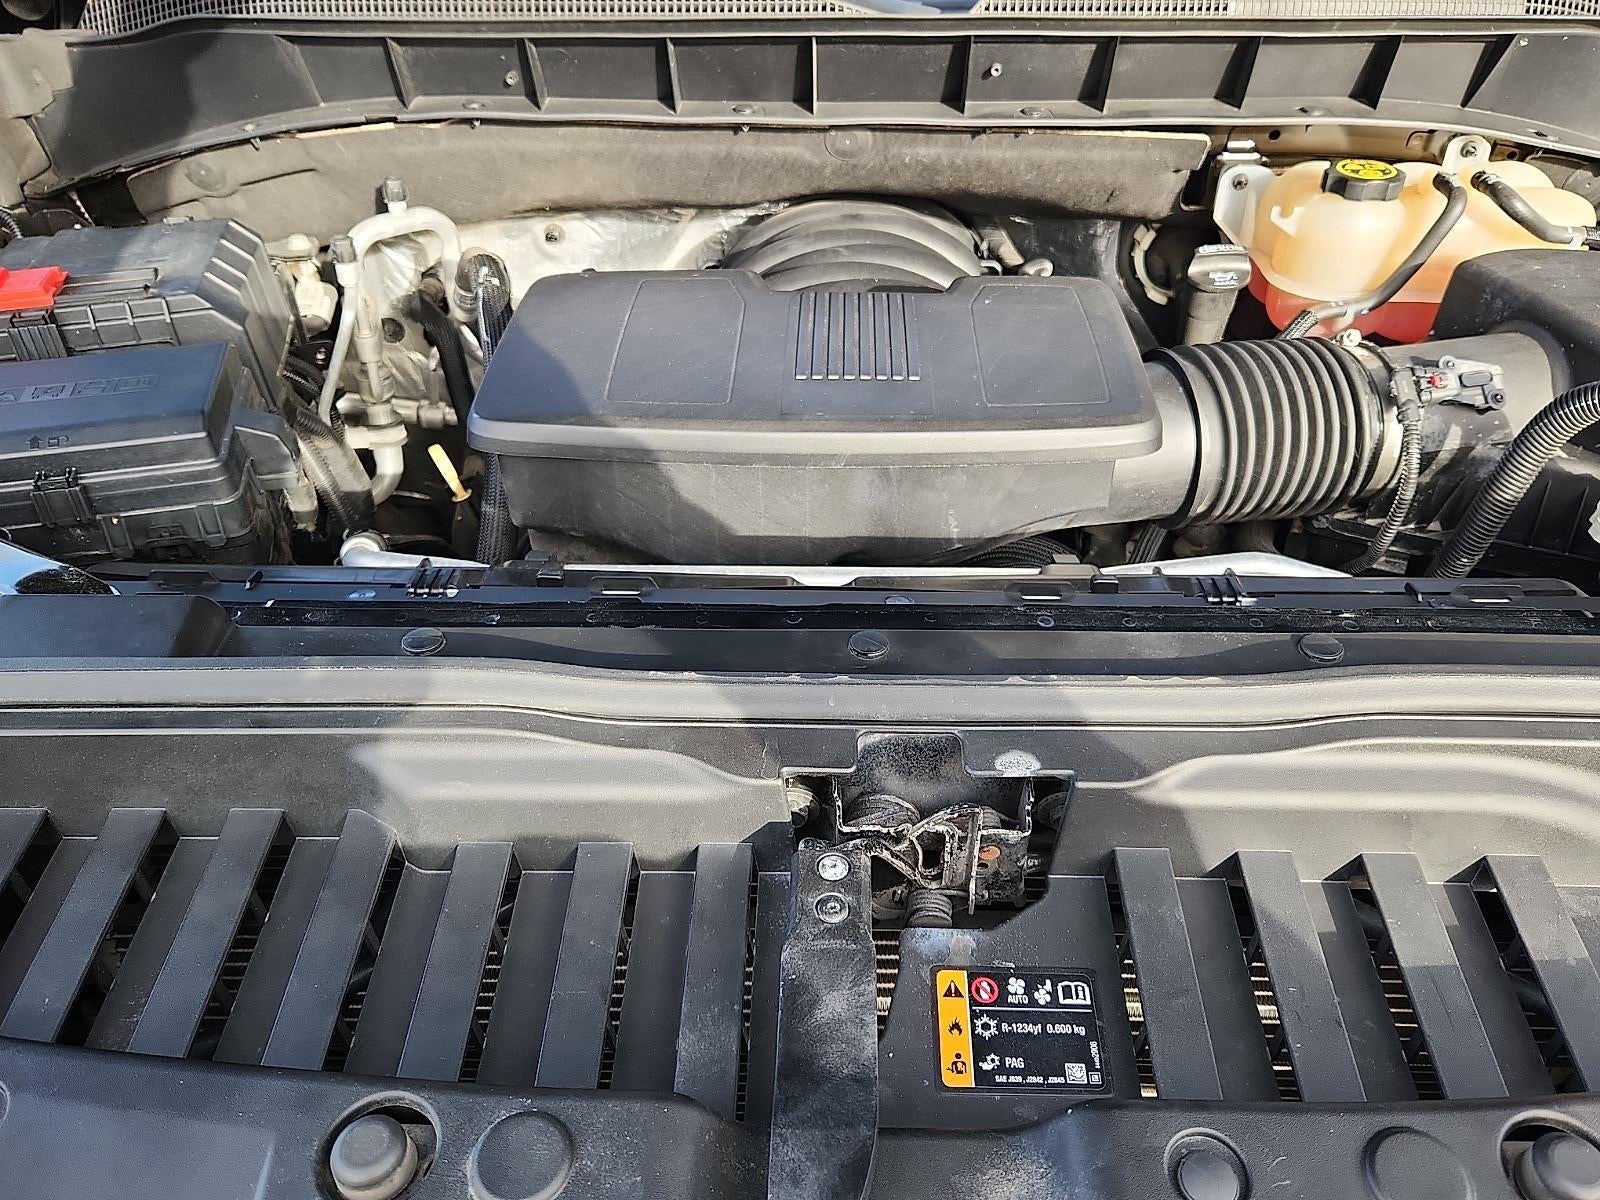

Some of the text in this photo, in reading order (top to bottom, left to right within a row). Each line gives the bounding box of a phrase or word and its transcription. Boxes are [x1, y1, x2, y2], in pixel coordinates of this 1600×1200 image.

[1007, 994, 1028, 1004] AUTO
[1001, 1022, 1086, 1036] R-1234yf 0.600 kg
[1004, 1056, 1025, 1069] PAG
[995, 1075, 1007, 1083] SAE
